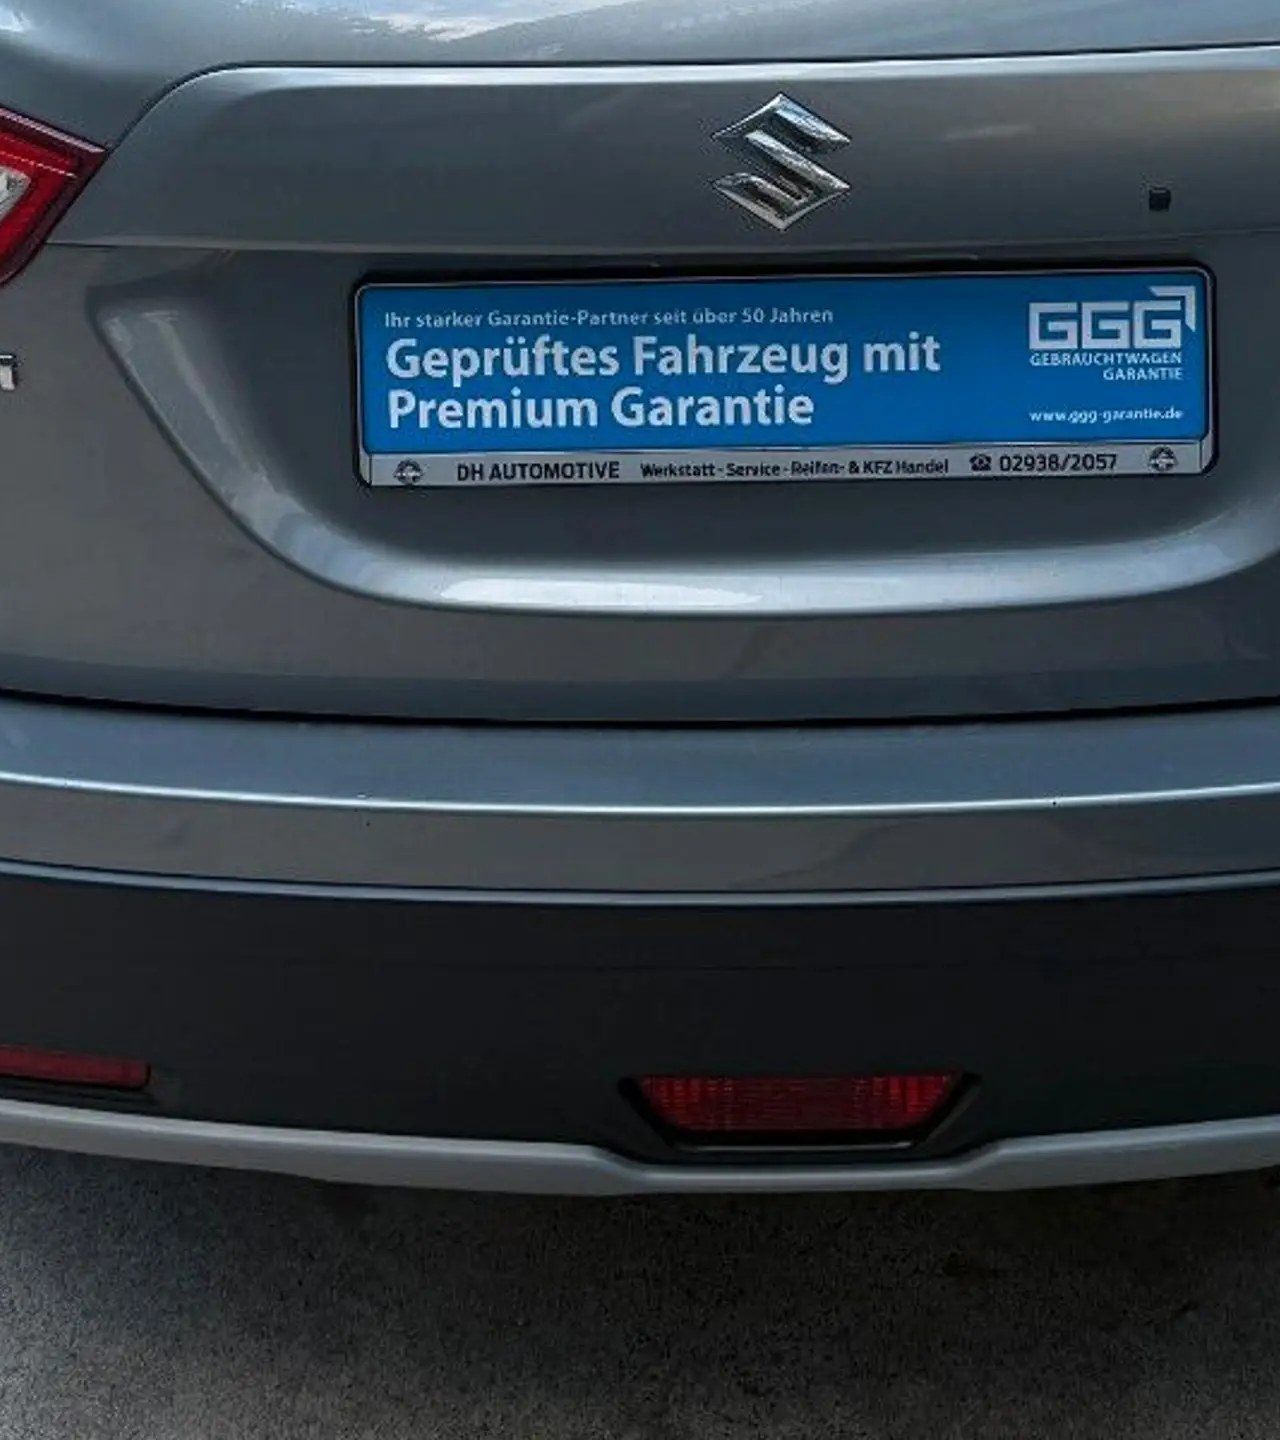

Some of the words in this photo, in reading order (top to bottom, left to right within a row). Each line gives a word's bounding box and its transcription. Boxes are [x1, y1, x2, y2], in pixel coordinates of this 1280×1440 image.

[385, 312, 410, 328] Ihr
[416, 312, 482, 328] starker
[488, 309, 648, 327] Garantie-Partner
[653, 309, 687, 325] seit
[692, 308, 738, 324] über
[742, 307, 764, 323] 50
[769, 307, 834, 323] Jahren
[1029, 300, 1182, 349] GGG
[386, 334, 619, 388] Geprüftes
[633, 333, 848, 384] Fahrzeug
[863, 331, 942, 372] mit
[1030, 351, 1182, 367] GEBRAUCHTWAGEN
[1103, 367, 1183, 381] GARANTIE
[388, 386, 598, 429] Premium
[611, 383, 815, 427] Garantie
[1029, 407, 1183, 424] www.ggg-garantie.de
[457, 464, 483, 482] DH
[489, 461, 619, 481] AUTOMOTIVE
[864, 459, 892, 474] KFZ
[999, 454, 1117, 472] 02938/2057
